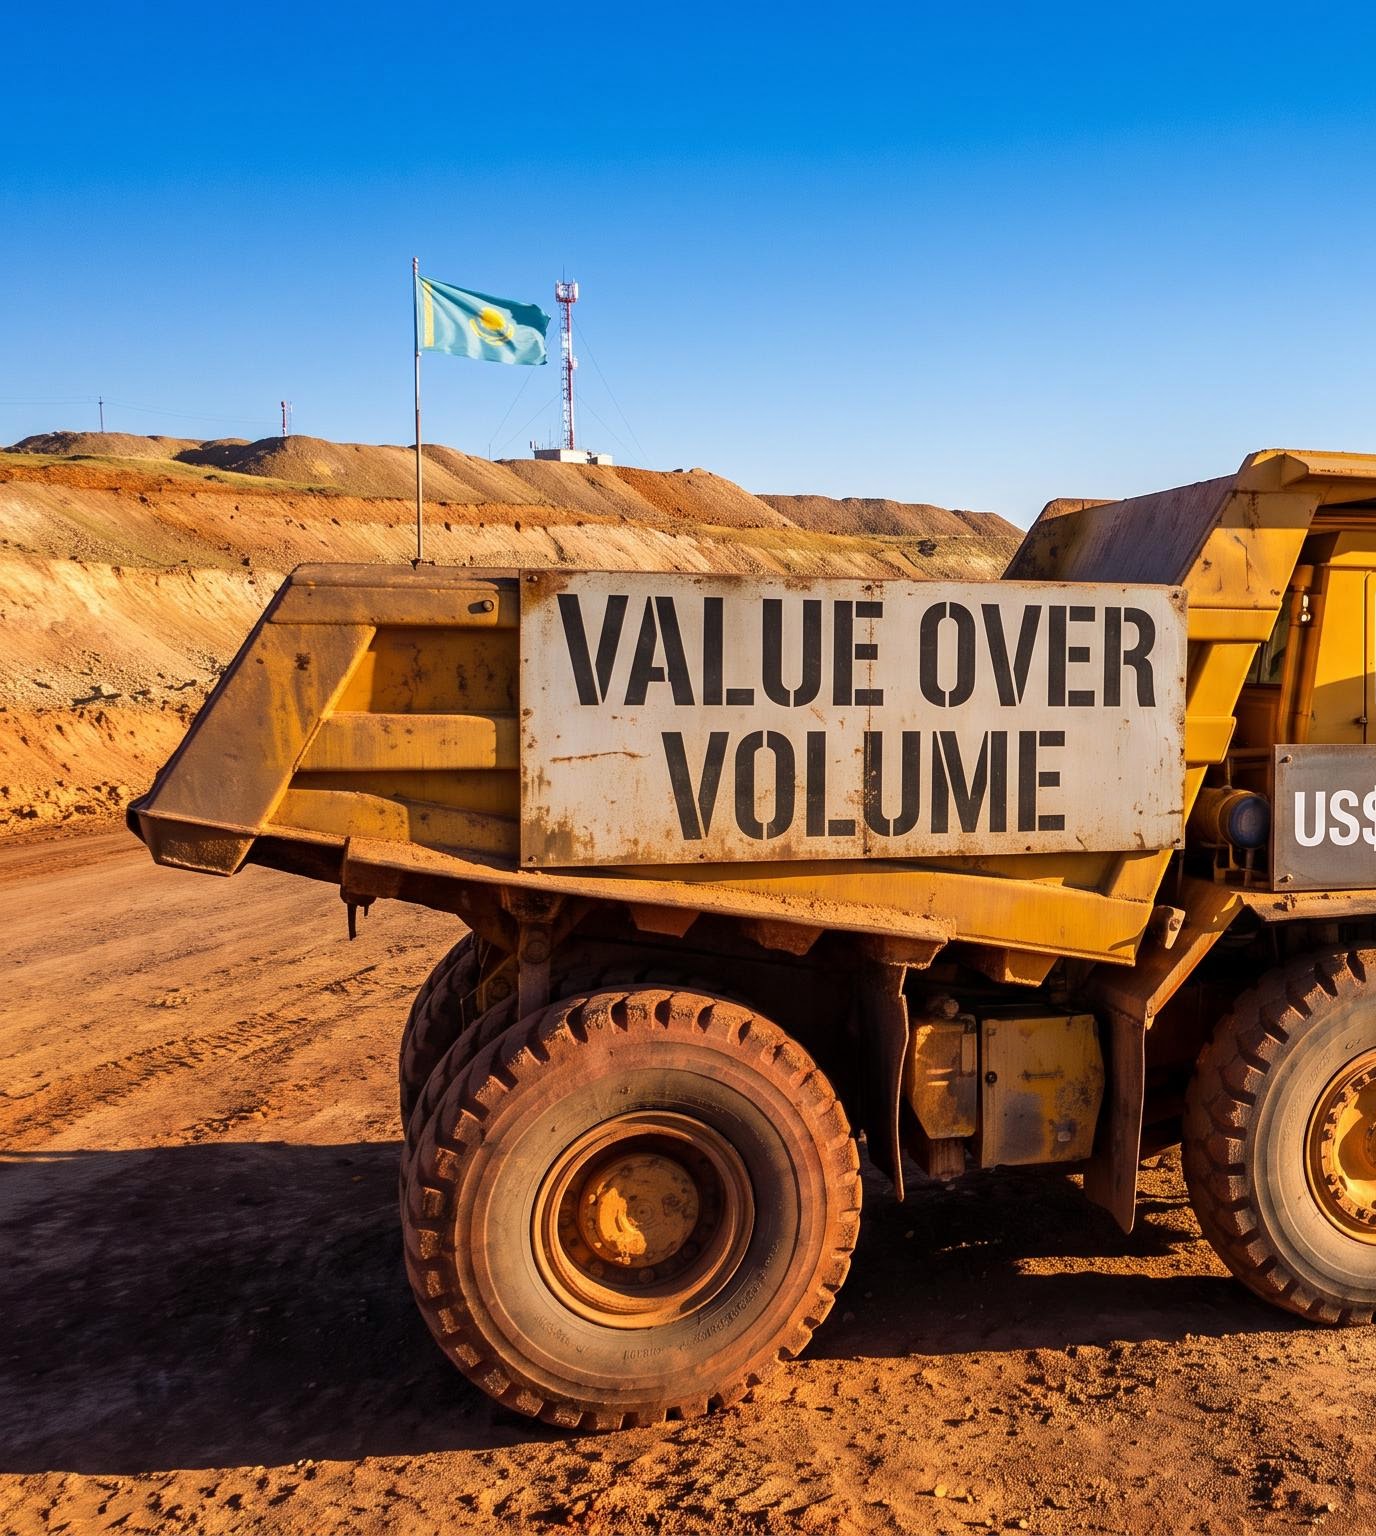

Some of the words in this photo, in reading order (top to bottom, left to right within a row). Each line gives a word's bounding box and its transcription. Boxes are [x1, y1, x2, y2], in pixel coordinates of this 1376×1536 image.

[556, 593, 885, 707] VALUE
[919, 601, 1157, 708] OVER
[661, 730, 1066, 841] VOLUME
